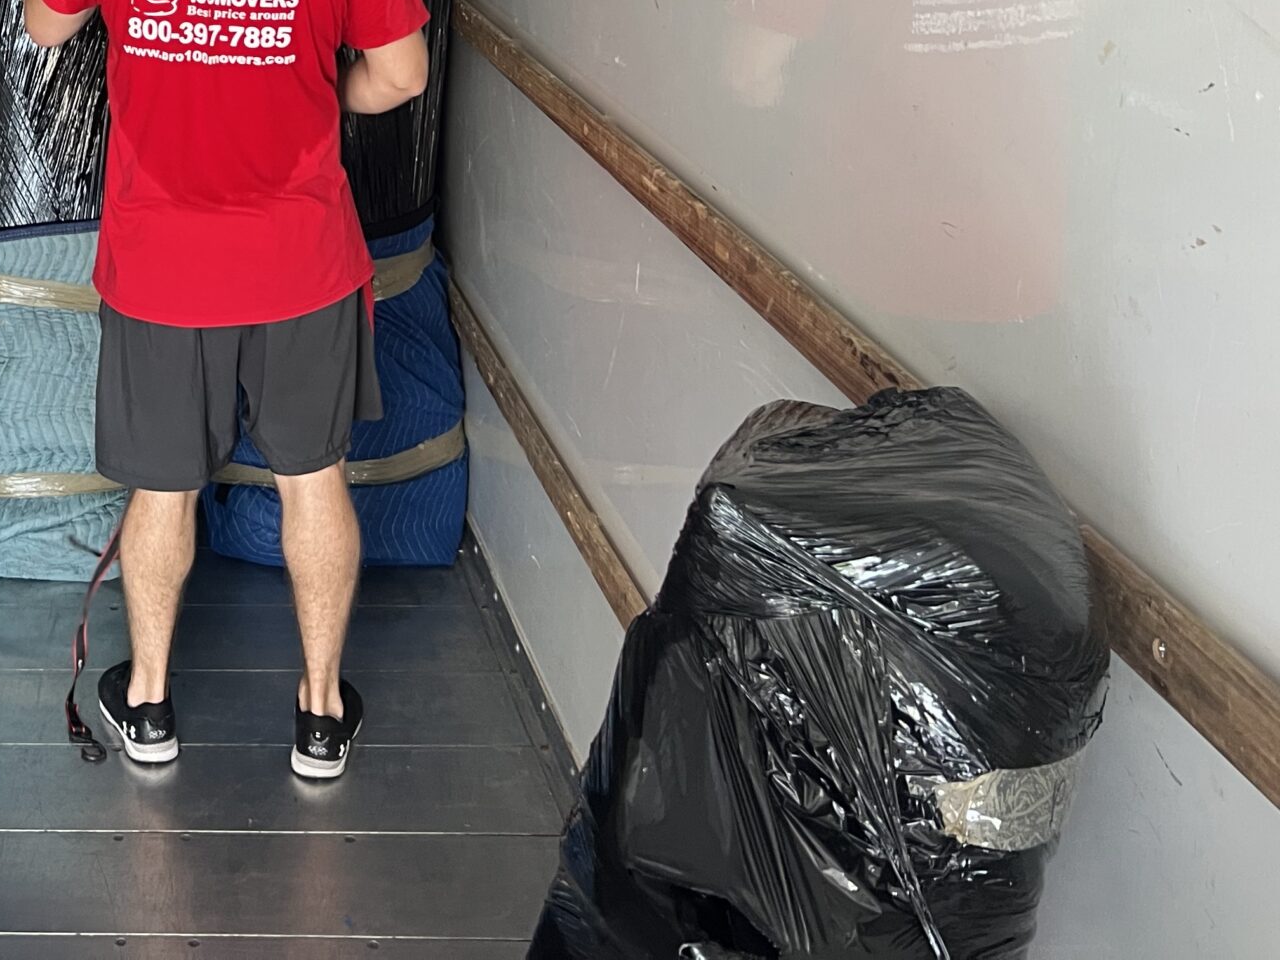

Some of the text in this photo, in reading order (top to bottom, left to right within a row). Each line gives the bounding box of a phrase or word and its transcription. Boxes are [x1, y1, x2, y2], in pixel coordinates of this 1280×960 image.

[213, 9, 246, 20] price
[249, 10, 295, 20] around
[128, 17, 292, 48] 800-397-7885
